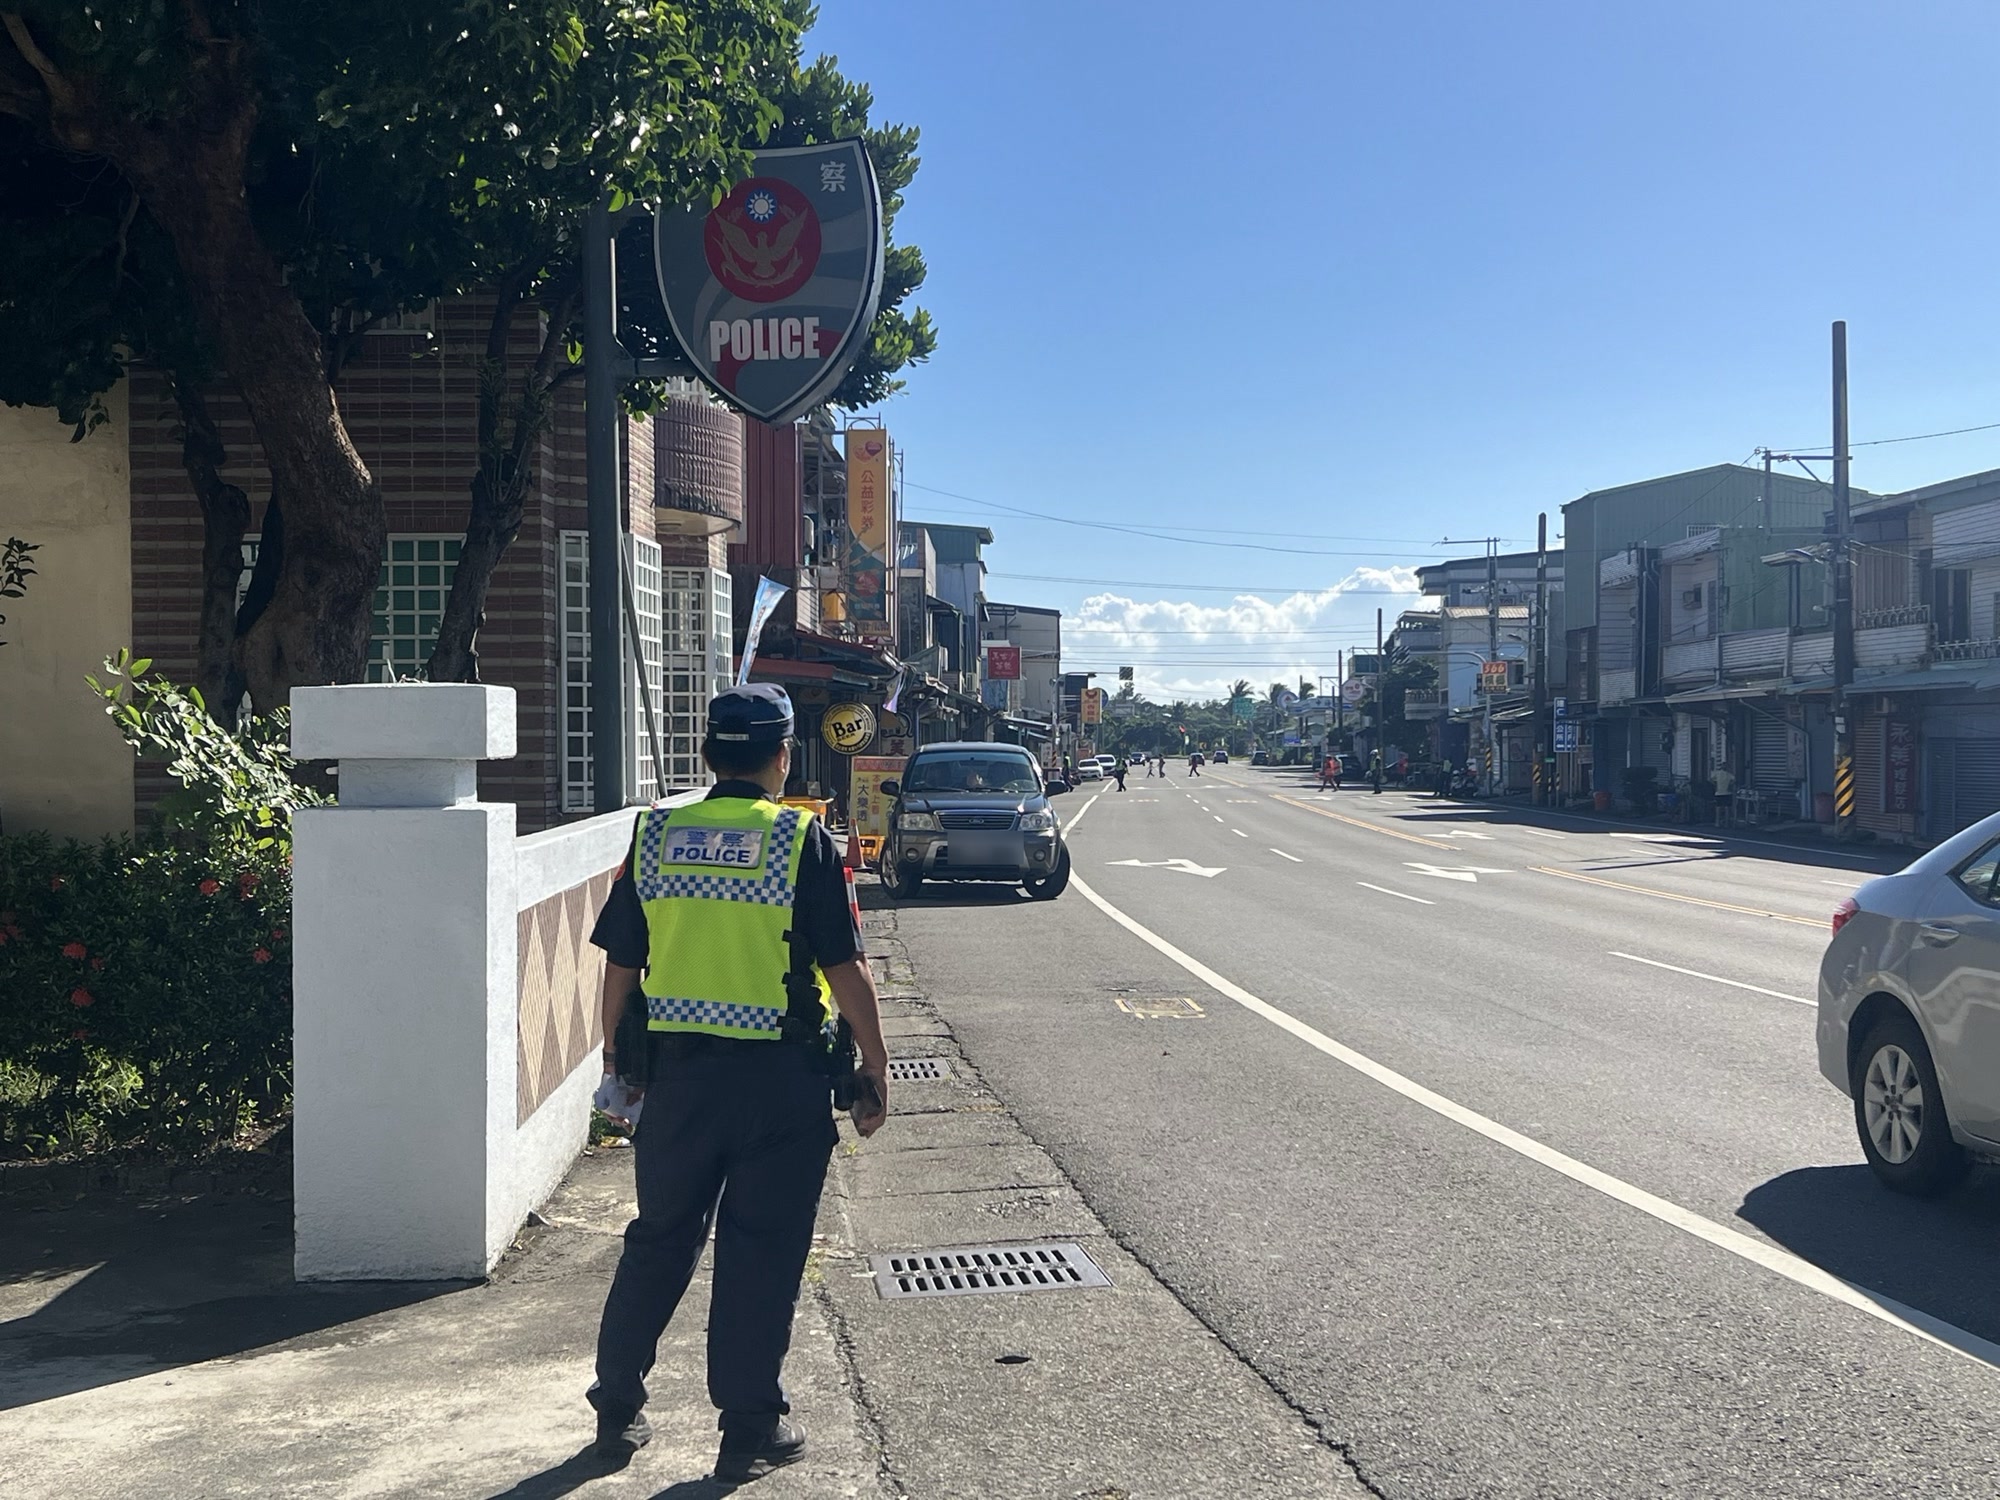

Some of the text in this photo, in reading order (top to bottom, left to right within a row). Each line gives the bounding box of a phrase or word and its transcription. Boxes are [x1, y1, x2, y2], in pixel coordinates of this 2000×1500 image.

[820, 161, 847, 192] 察
[709, 317, 820, 362] POLICE
[861, 469, 875, 530] 公益彩券
[1484, 664, 1505, 673] 566
[831, 718, 863, 738] Bar
[672, 847, 751, 863] POLICE
